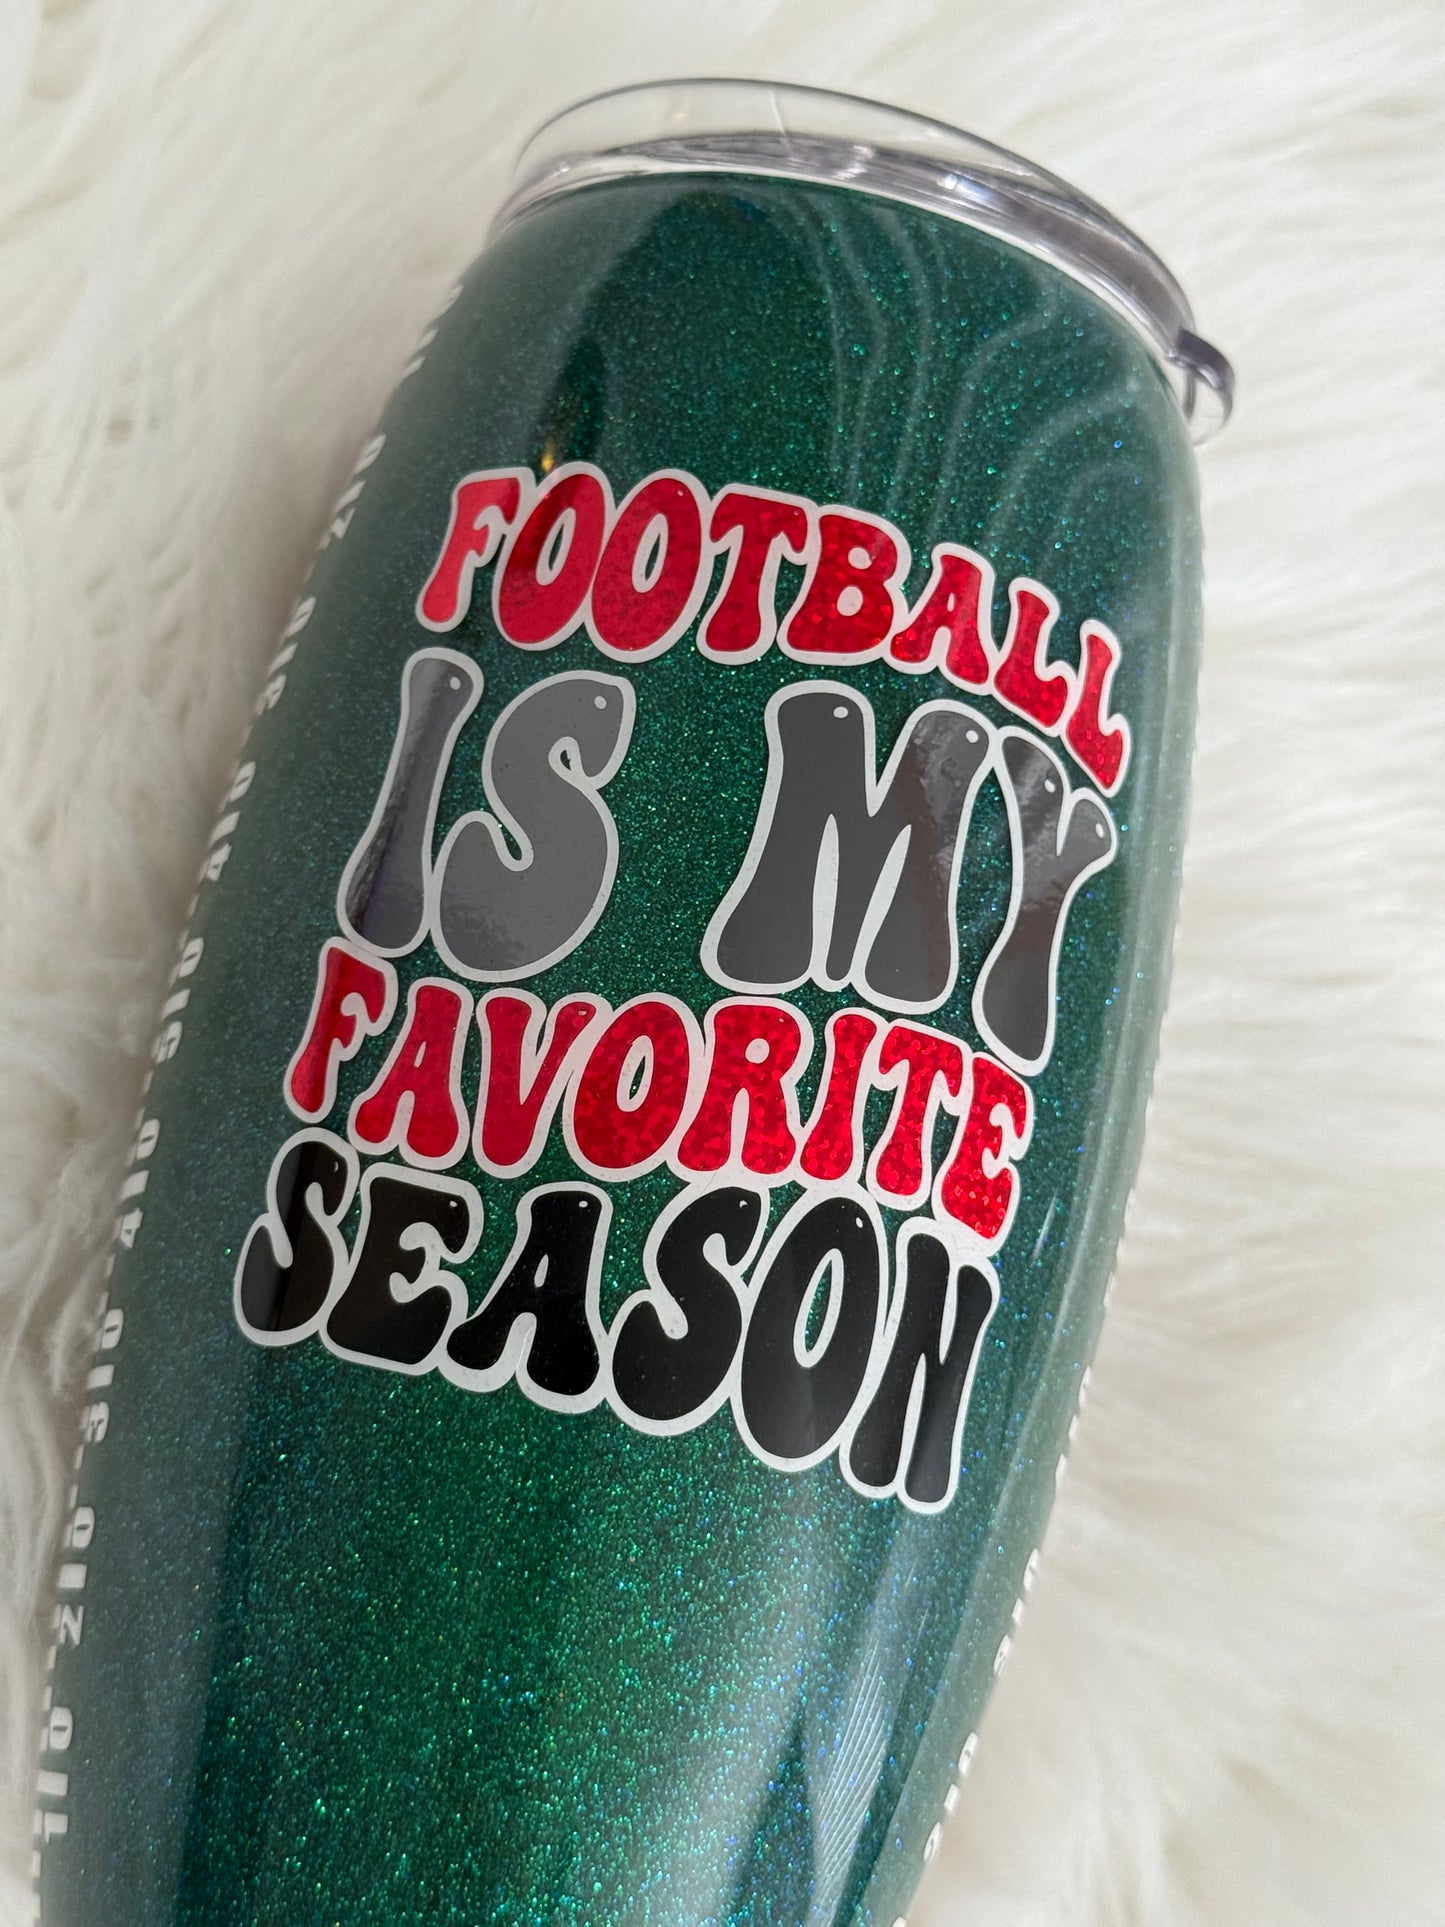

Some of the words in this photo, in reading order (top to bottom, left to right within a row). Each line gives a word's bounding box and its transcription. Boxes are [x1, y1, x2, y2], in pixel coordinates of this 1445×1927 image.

[417, 463, 1128, 796] FOOTBALL
[337, 648, 636, 983] IS
[700, 680, 1118, 1076] MY
[284, 937, 1034, 1250] FAVORITE
[234, 1129, 1000, 1513] SEASON
